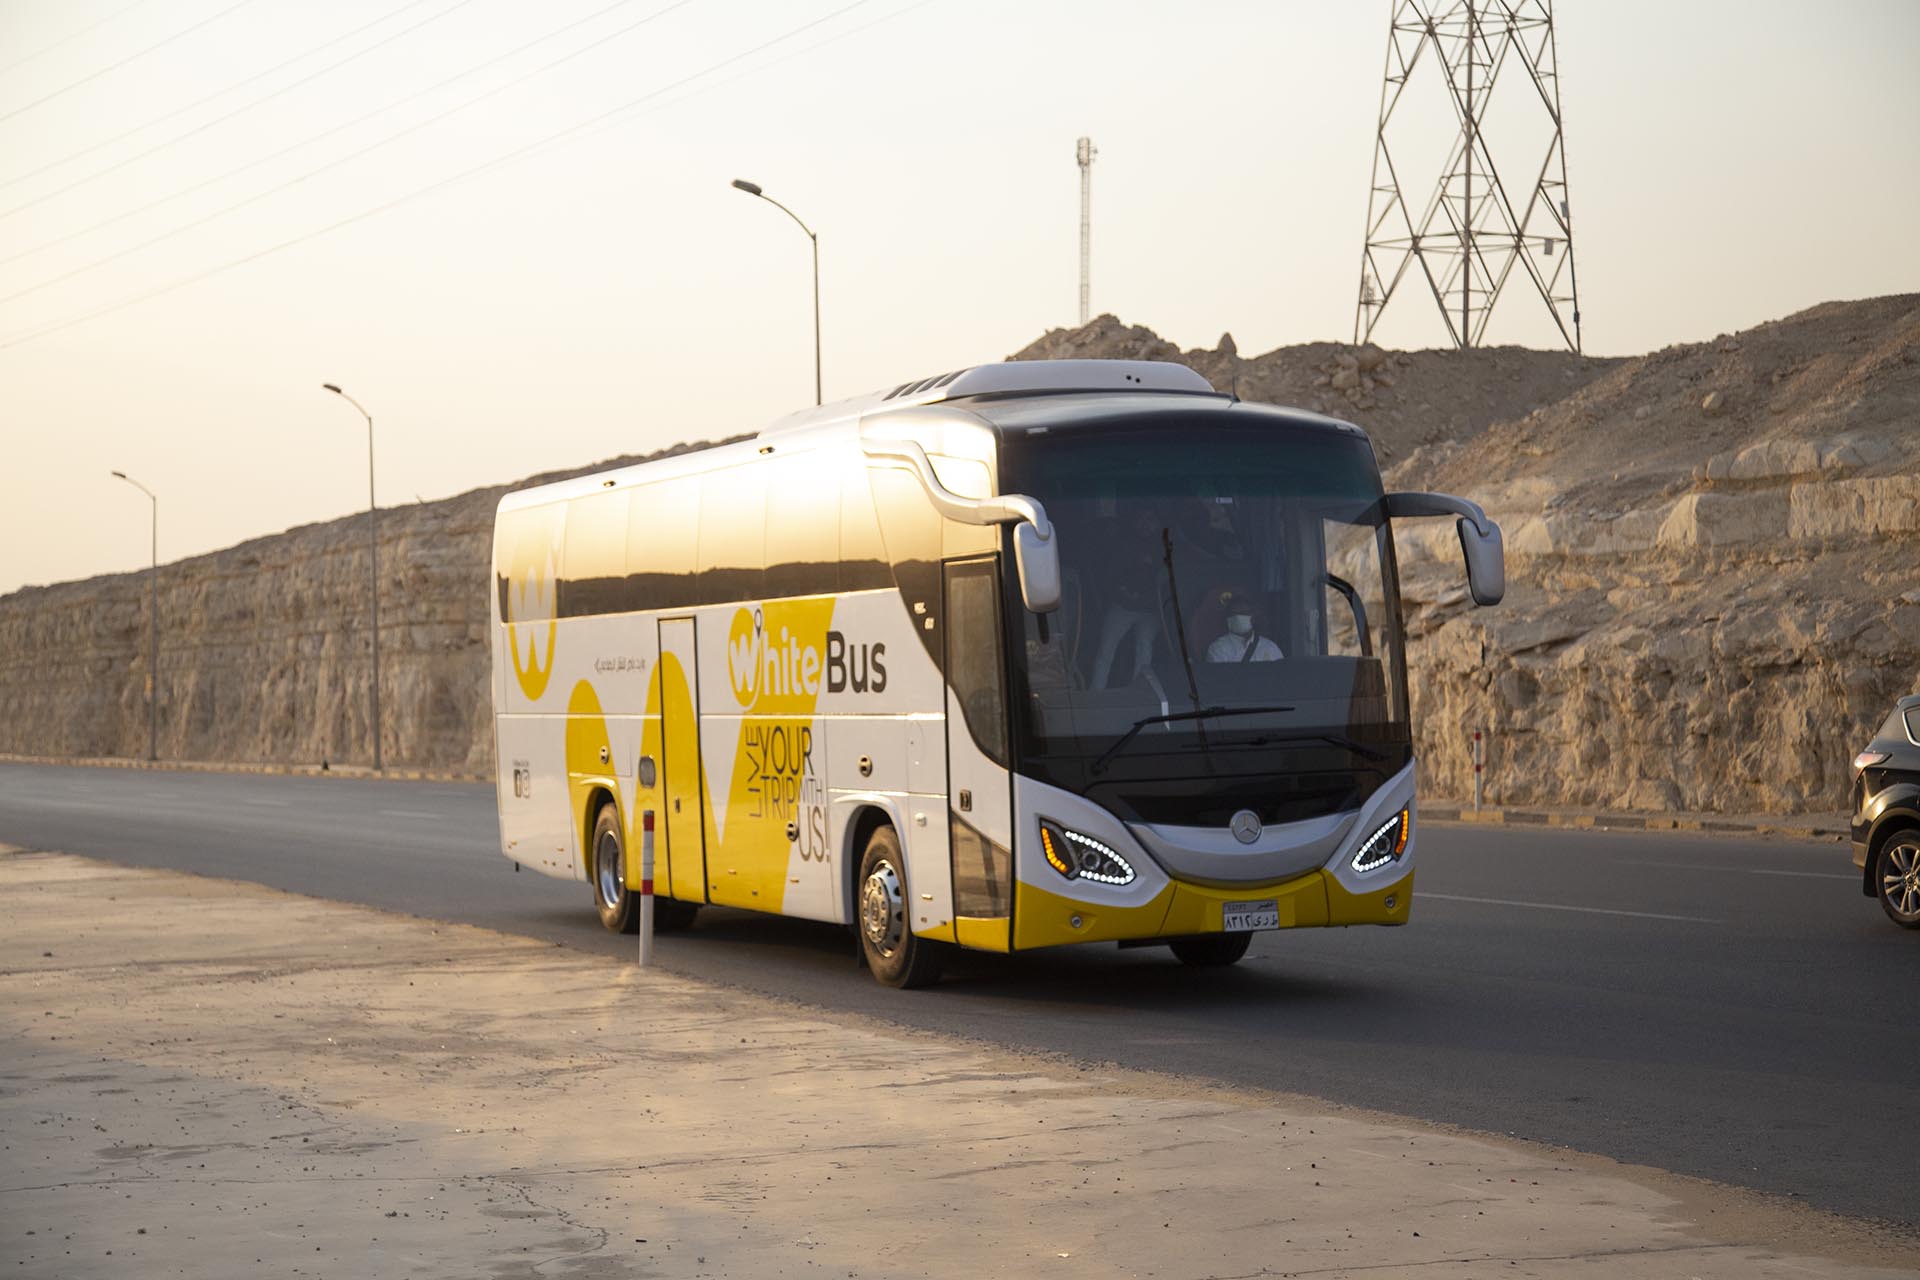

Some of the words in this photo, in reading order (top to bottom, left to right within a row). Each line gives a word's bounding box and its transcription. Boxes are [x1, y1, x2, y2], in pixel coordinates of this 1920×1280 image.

[729, 619, 819, 696] White
[826, 630, 887, 693] Bus
[745, 726, 762, 818] LIVE
[757, 725, 815, 775] YOUR
[760, 776, 796, 820] TRIP
[797, 805, 830, 863] US!
